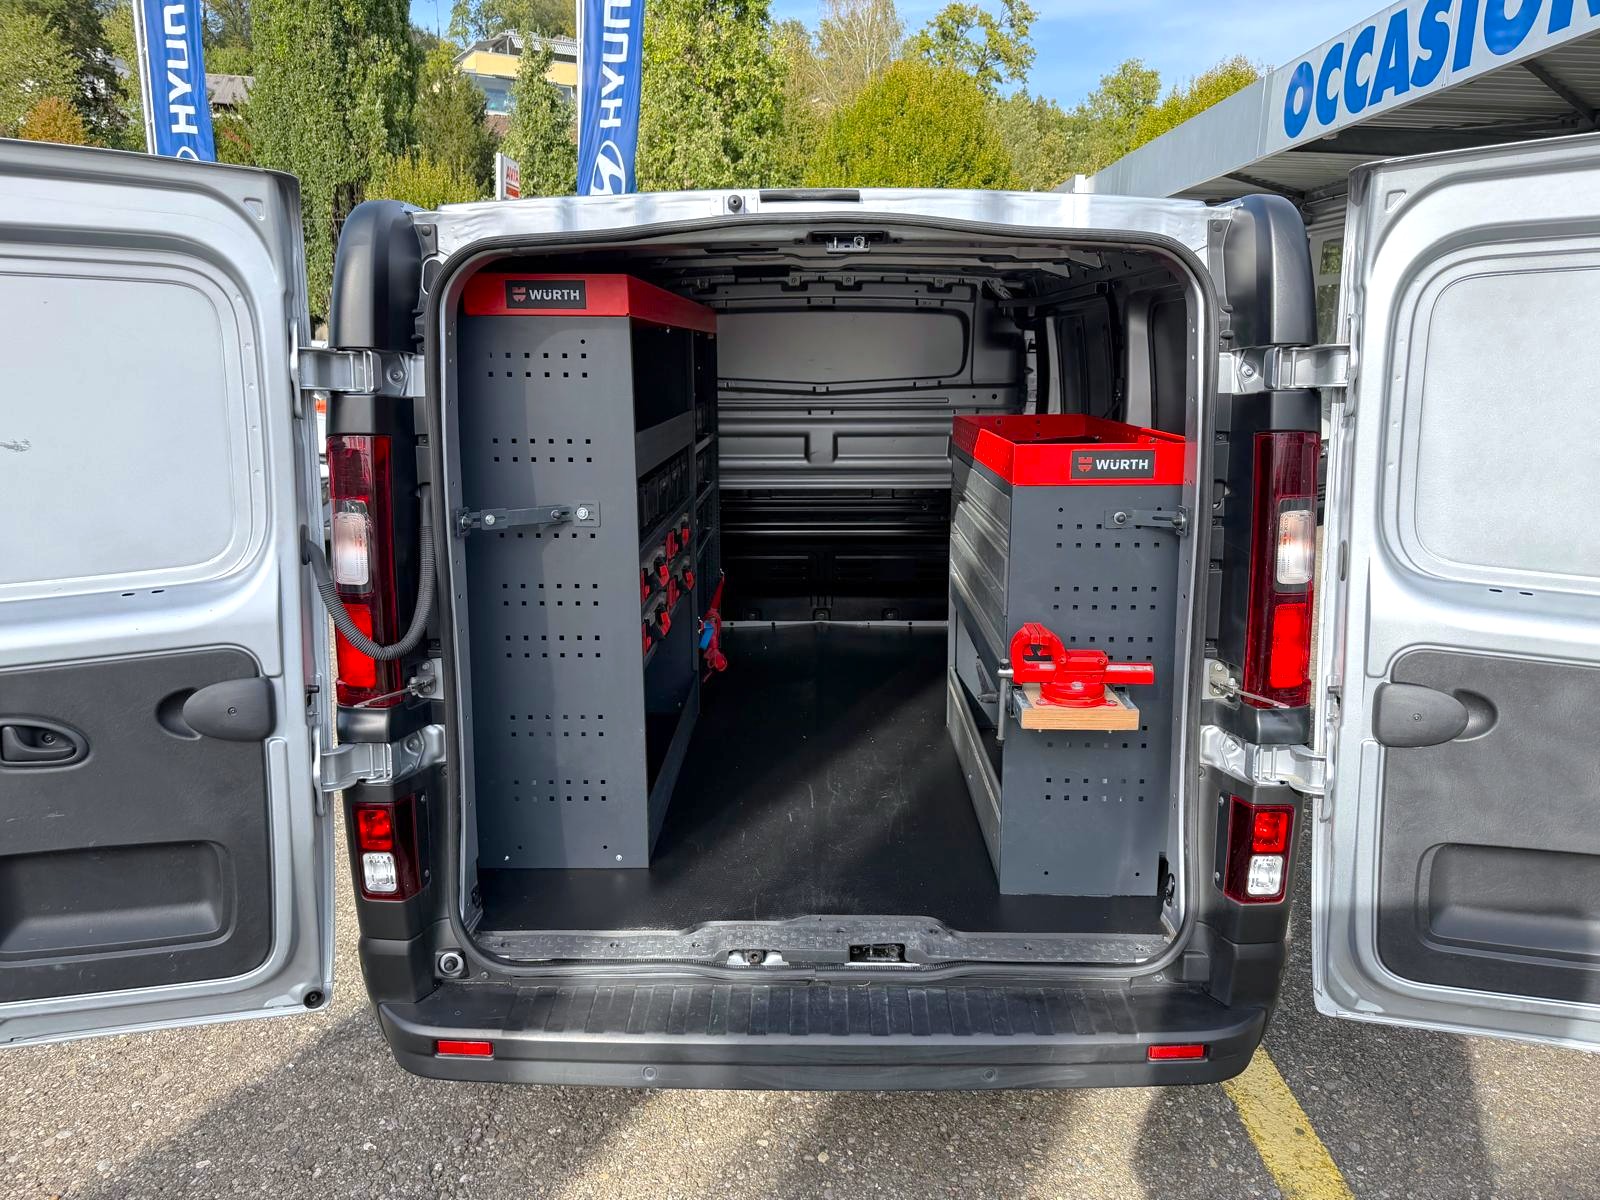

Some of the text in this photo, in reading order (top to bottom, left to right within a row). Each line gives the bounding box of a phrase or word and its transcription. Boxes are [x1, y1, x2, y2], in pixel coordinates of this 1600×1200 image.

[163, 4, 199, 135] HYUN
[1283, 0, 1600, 139] OCCASIO
[529, 289, 580, 301] WÜRTH
[1096, 459, 1149, 470] WÜRTH
